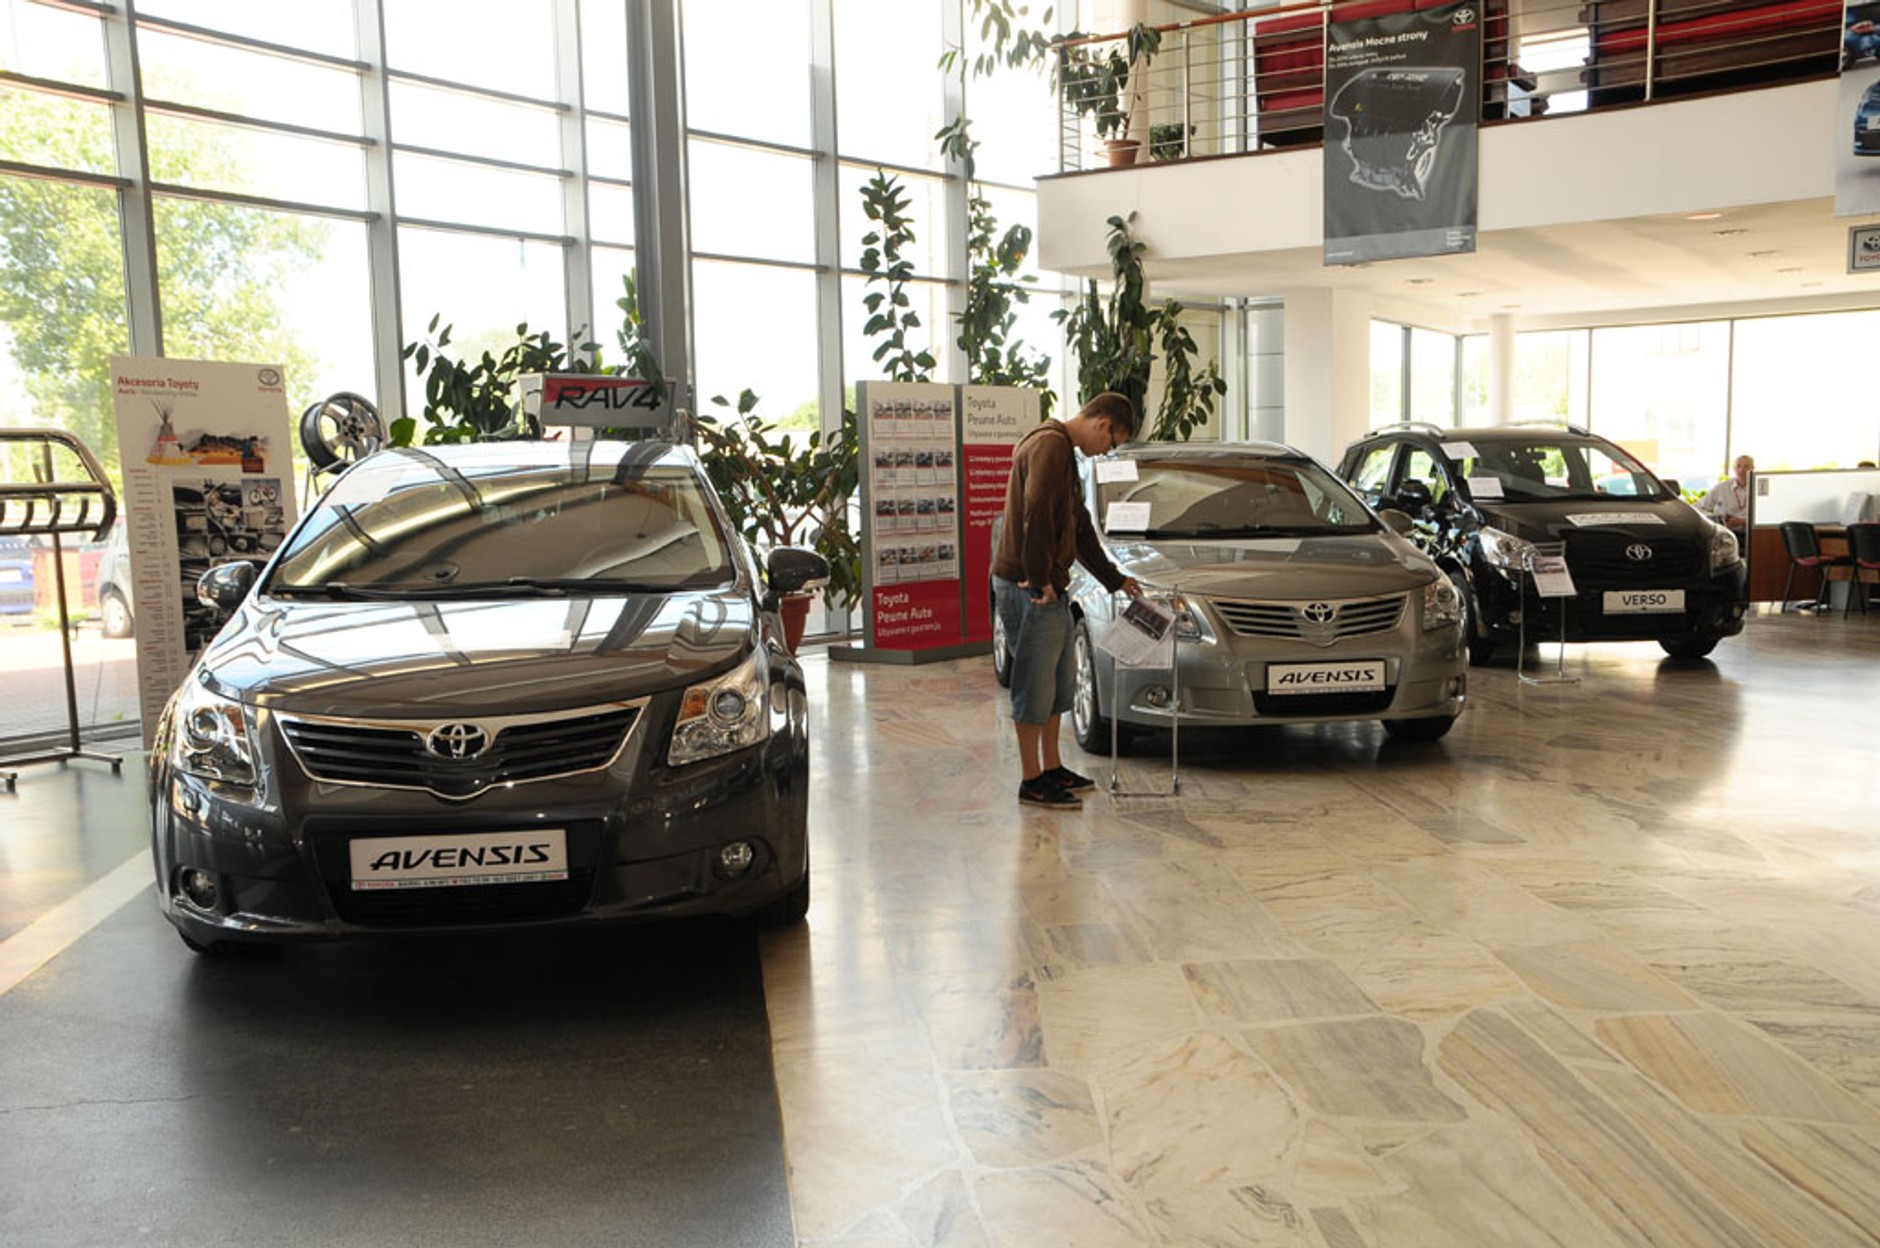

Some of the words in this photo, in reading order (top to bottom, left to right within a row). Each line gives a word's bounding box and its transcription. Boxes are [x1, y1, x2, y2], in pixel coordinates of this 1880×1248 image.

[1329, 39, 1364, 52] Avensis
[1365, 35, 1396, 47] Mocne
[1397, 31, 1428, 43] strony
[118, 376, 166, 388] Akcesoria
[167, 377, 199, 391] Toyoty
[554, 386, 661, 411] RAV4
[967, 396, 997, 411] Toyota
[997, 413, 1017, 425] Auto
[876, 592, 909, 608] Toyota
[1622, 593, 1667, 606] VERSO
[910, 607, 933, 619] Auto
[1278, 669, 1375, 684] AVENSIS
[369, 844, 550, 871] AVENSIS
